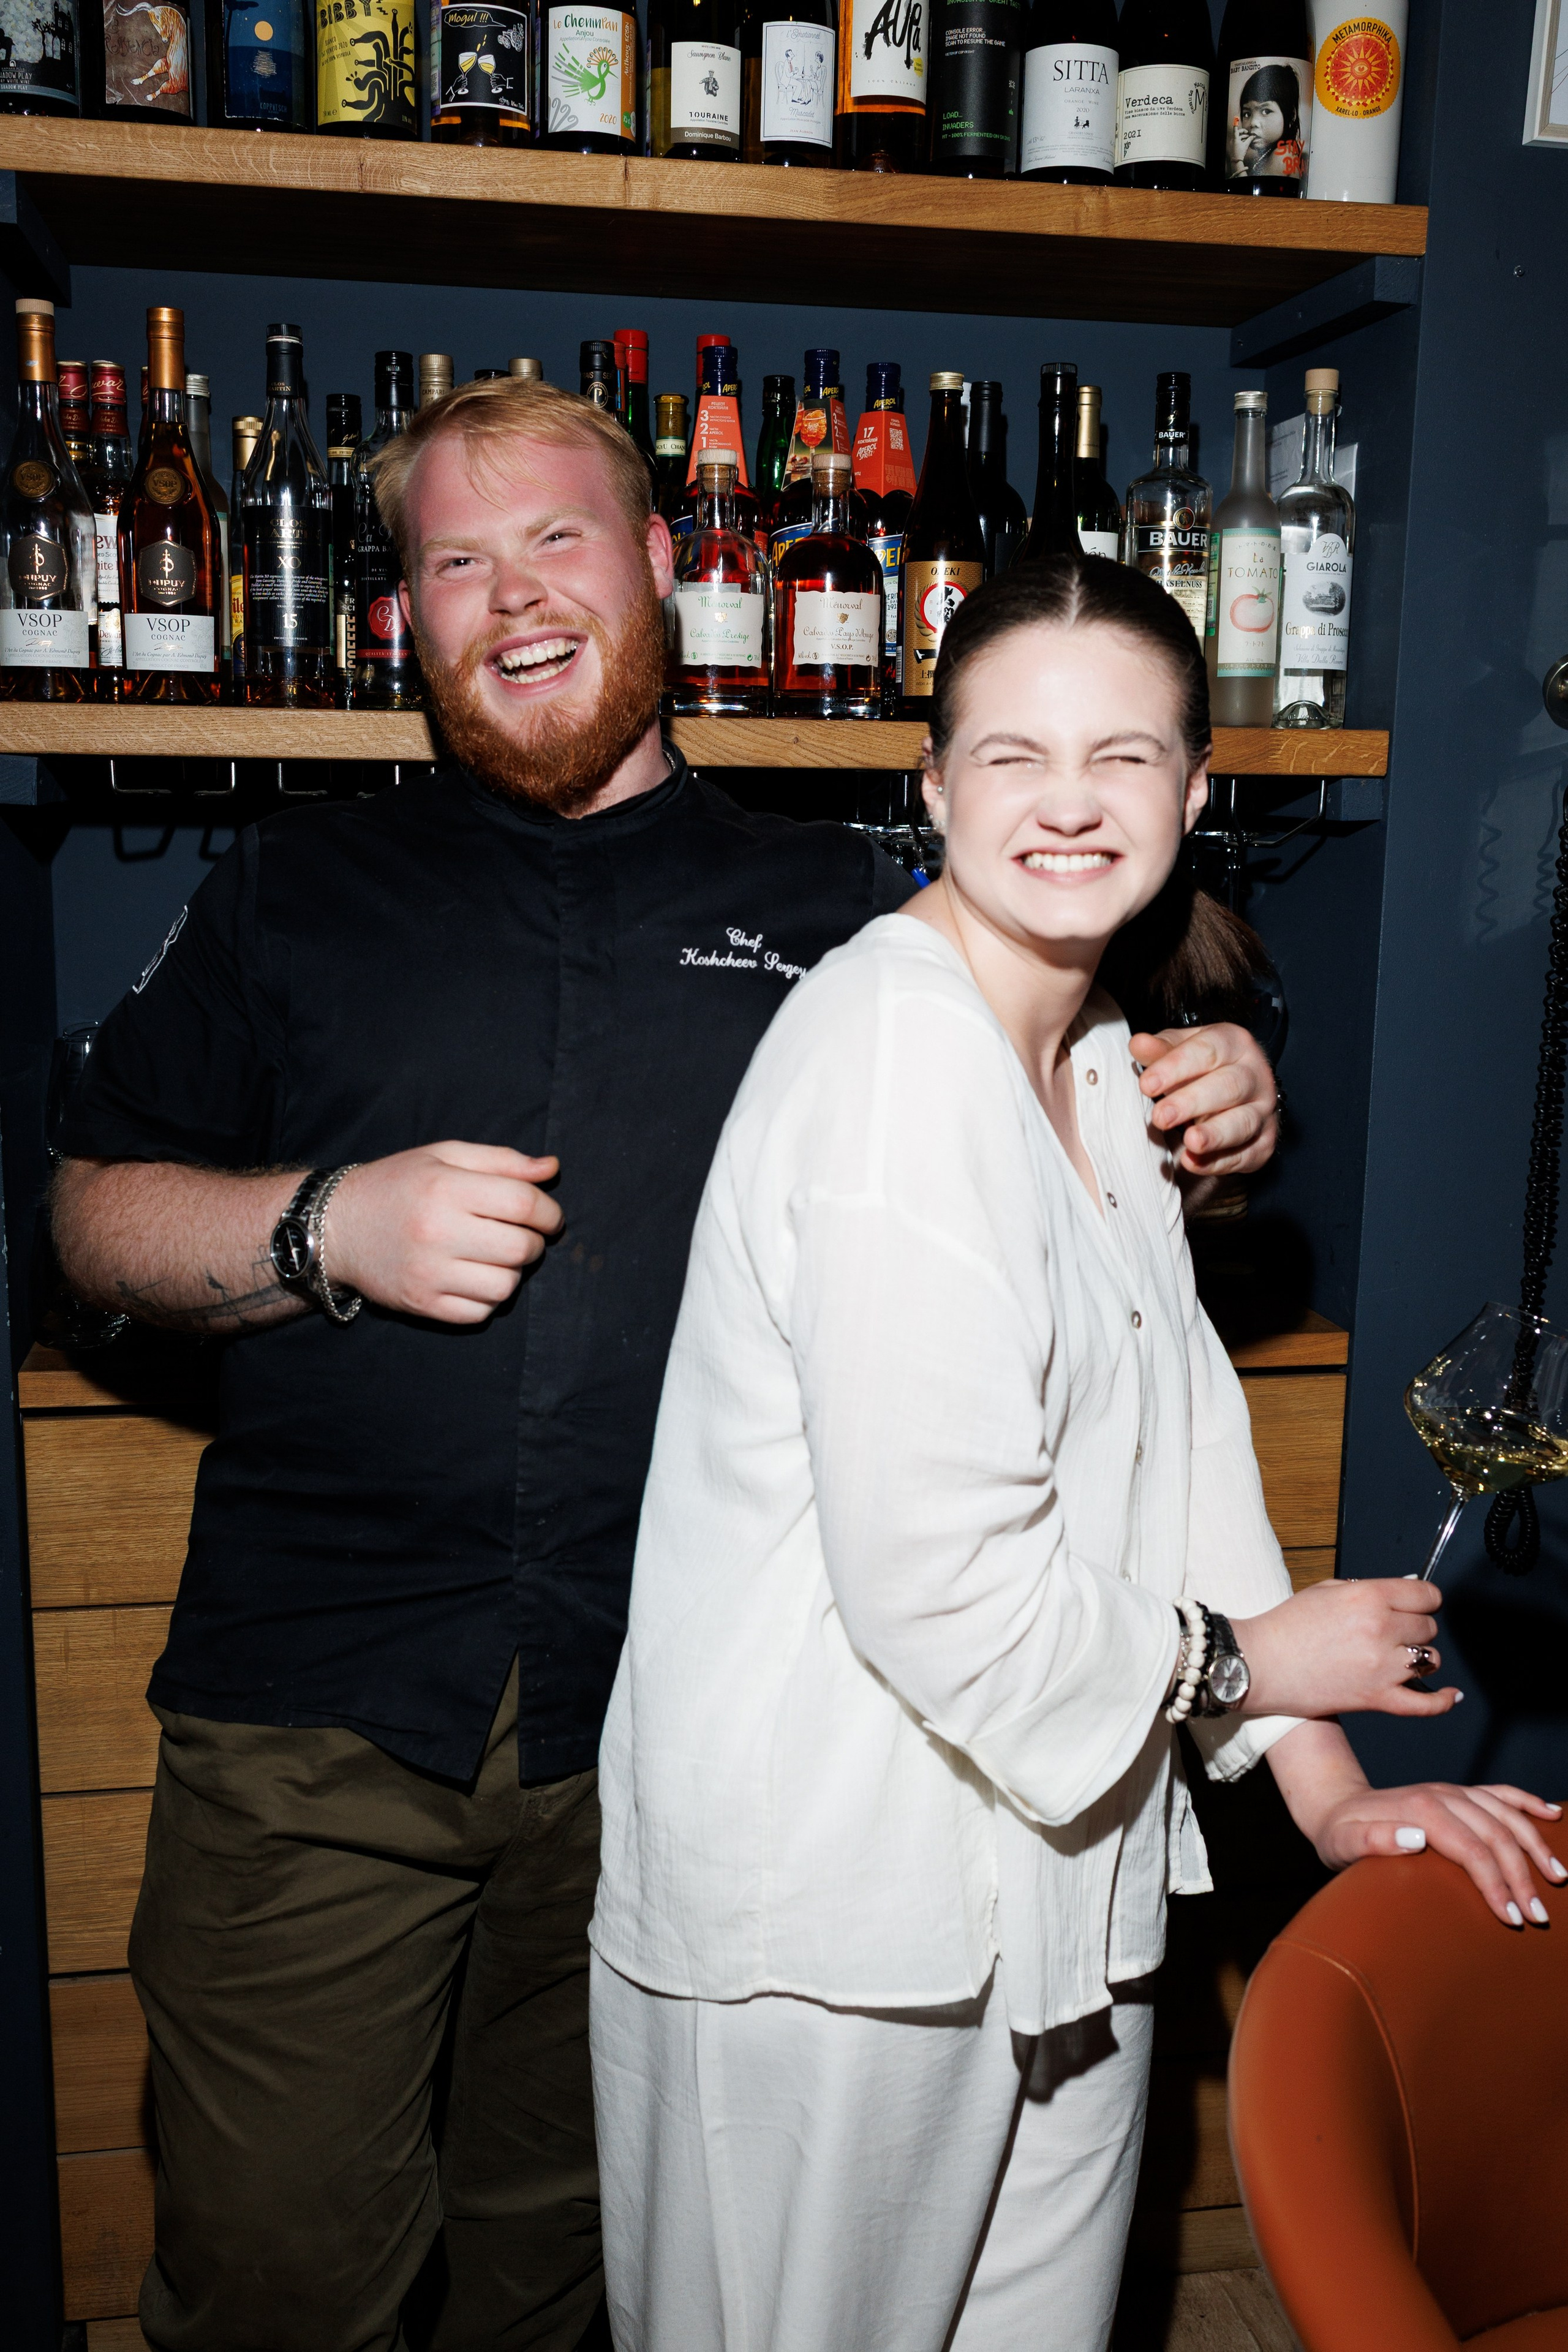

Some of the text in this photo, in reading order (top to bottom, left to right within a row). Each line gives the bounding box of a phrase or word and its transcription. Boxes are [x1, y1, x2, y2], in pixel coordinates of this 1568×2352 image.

[320, 0, 372, 30] BIBBY
[448, 12, 489, 26] Mogul !!!
[553, 20, 562, 29] Le
[1332, 21, 1392, 44] METAMORPHIKA
[687, 50, 715, 61] Sauvignon
[1053, 59, 1110, 85] SITTA
[1231, 66, 1241, 74] BABY
[1065, 86, 1100, 95] LARANXA
[1125, 95, 1174, 109] Verdeca
[689, 111, 728, 122] TOURAINE
[789, 107, 815, 118] Muscadet
[1363, 105, 1382, 116] ORANGE
[600, 113, 617, 125] 2020
[942, 122, 974, 130] INVADERS
[714, 133, 731, 142] Barbou
[1123, 129, 1142, 140] 2021
[1274, 139, 1306, 159] STAY
[873, 398, 896, 409] APEROL
[700, 410, 709, 421] 3
[833, 412, 837, 424] 3
[699, 423, 709, 435] 2
[834, 426, 839, 437] 2
[864, 426, 875, 439] 17
[701, 437, 706, 448] 1
[836, 439, 840, 451] 1
[856, 443, 877, 458] APEROL
[153, 479, 178, 488] VSOP
[1149, 531, 1208, 548] BAUER
[277, 556, 301, 569] XO
[1253, 552, 1264, 563] La
[931, 567, 960, 576] OEKI
[1227, 567, 1278, 579] TOMATO
[1306, 562, 1347, 573] GIAROLA
[698, 596, 743, 608] Morval
[820, 597, 863, 610] Ménorval
[17, 613, 62, 628] VSOP
[146, 618, 190, 632] VSOP
[282, 612, 298, 628] 15
[722, 629, 750, 644] Prestige
[835, 627, 854, 642] Pays
[1286, 622, 1316, 639] Grappa
[1317, 622, 1326, 636] di
[1295, 654, 1310, 663] Villa
[1311, 654, 1328, 664] Dalla
[726, 927, 763, 953] Chef
[680, 948, 807, 980] Koshcheev Sergey
